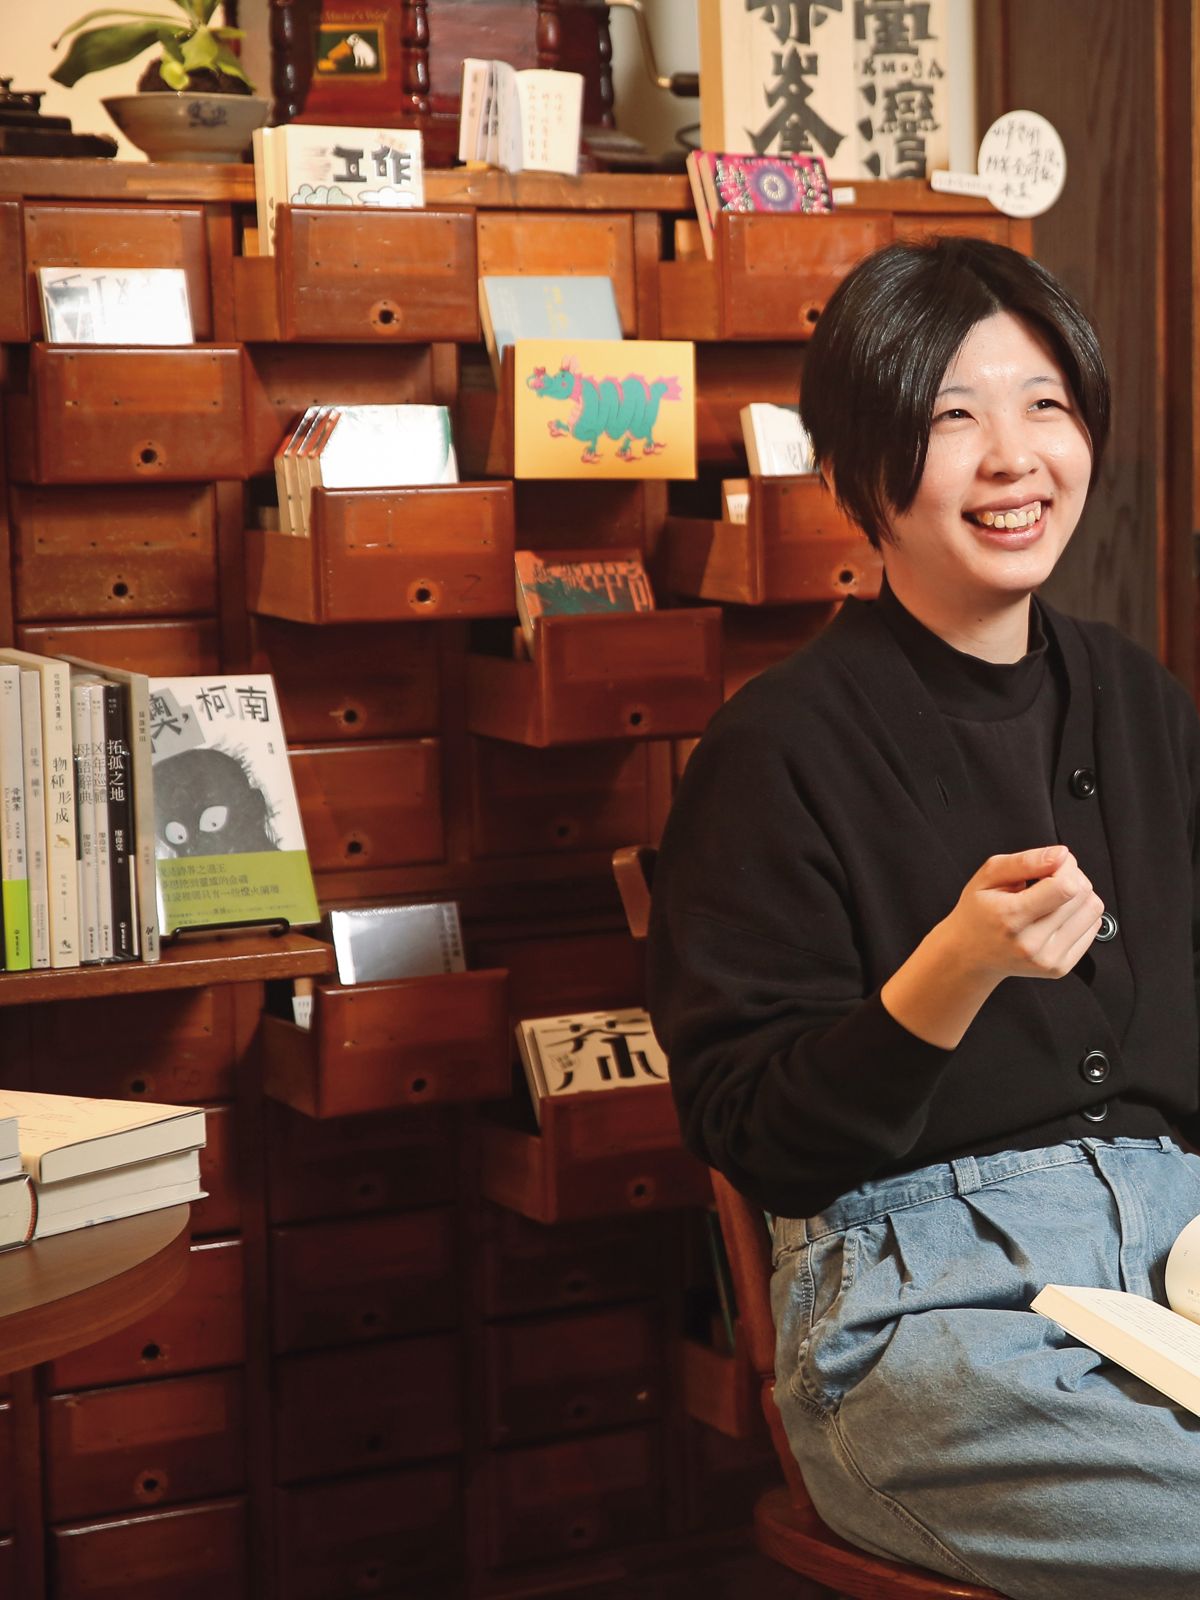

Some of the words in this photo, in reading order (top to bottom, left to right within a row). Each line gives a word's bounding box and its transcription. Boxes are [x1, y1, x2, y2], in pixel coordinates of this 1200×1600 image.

[333, 145, 411, 184] 工作
[50, 757, 73, 824] 物種形成
[107, 739, 126, 801] 拓孤之地
